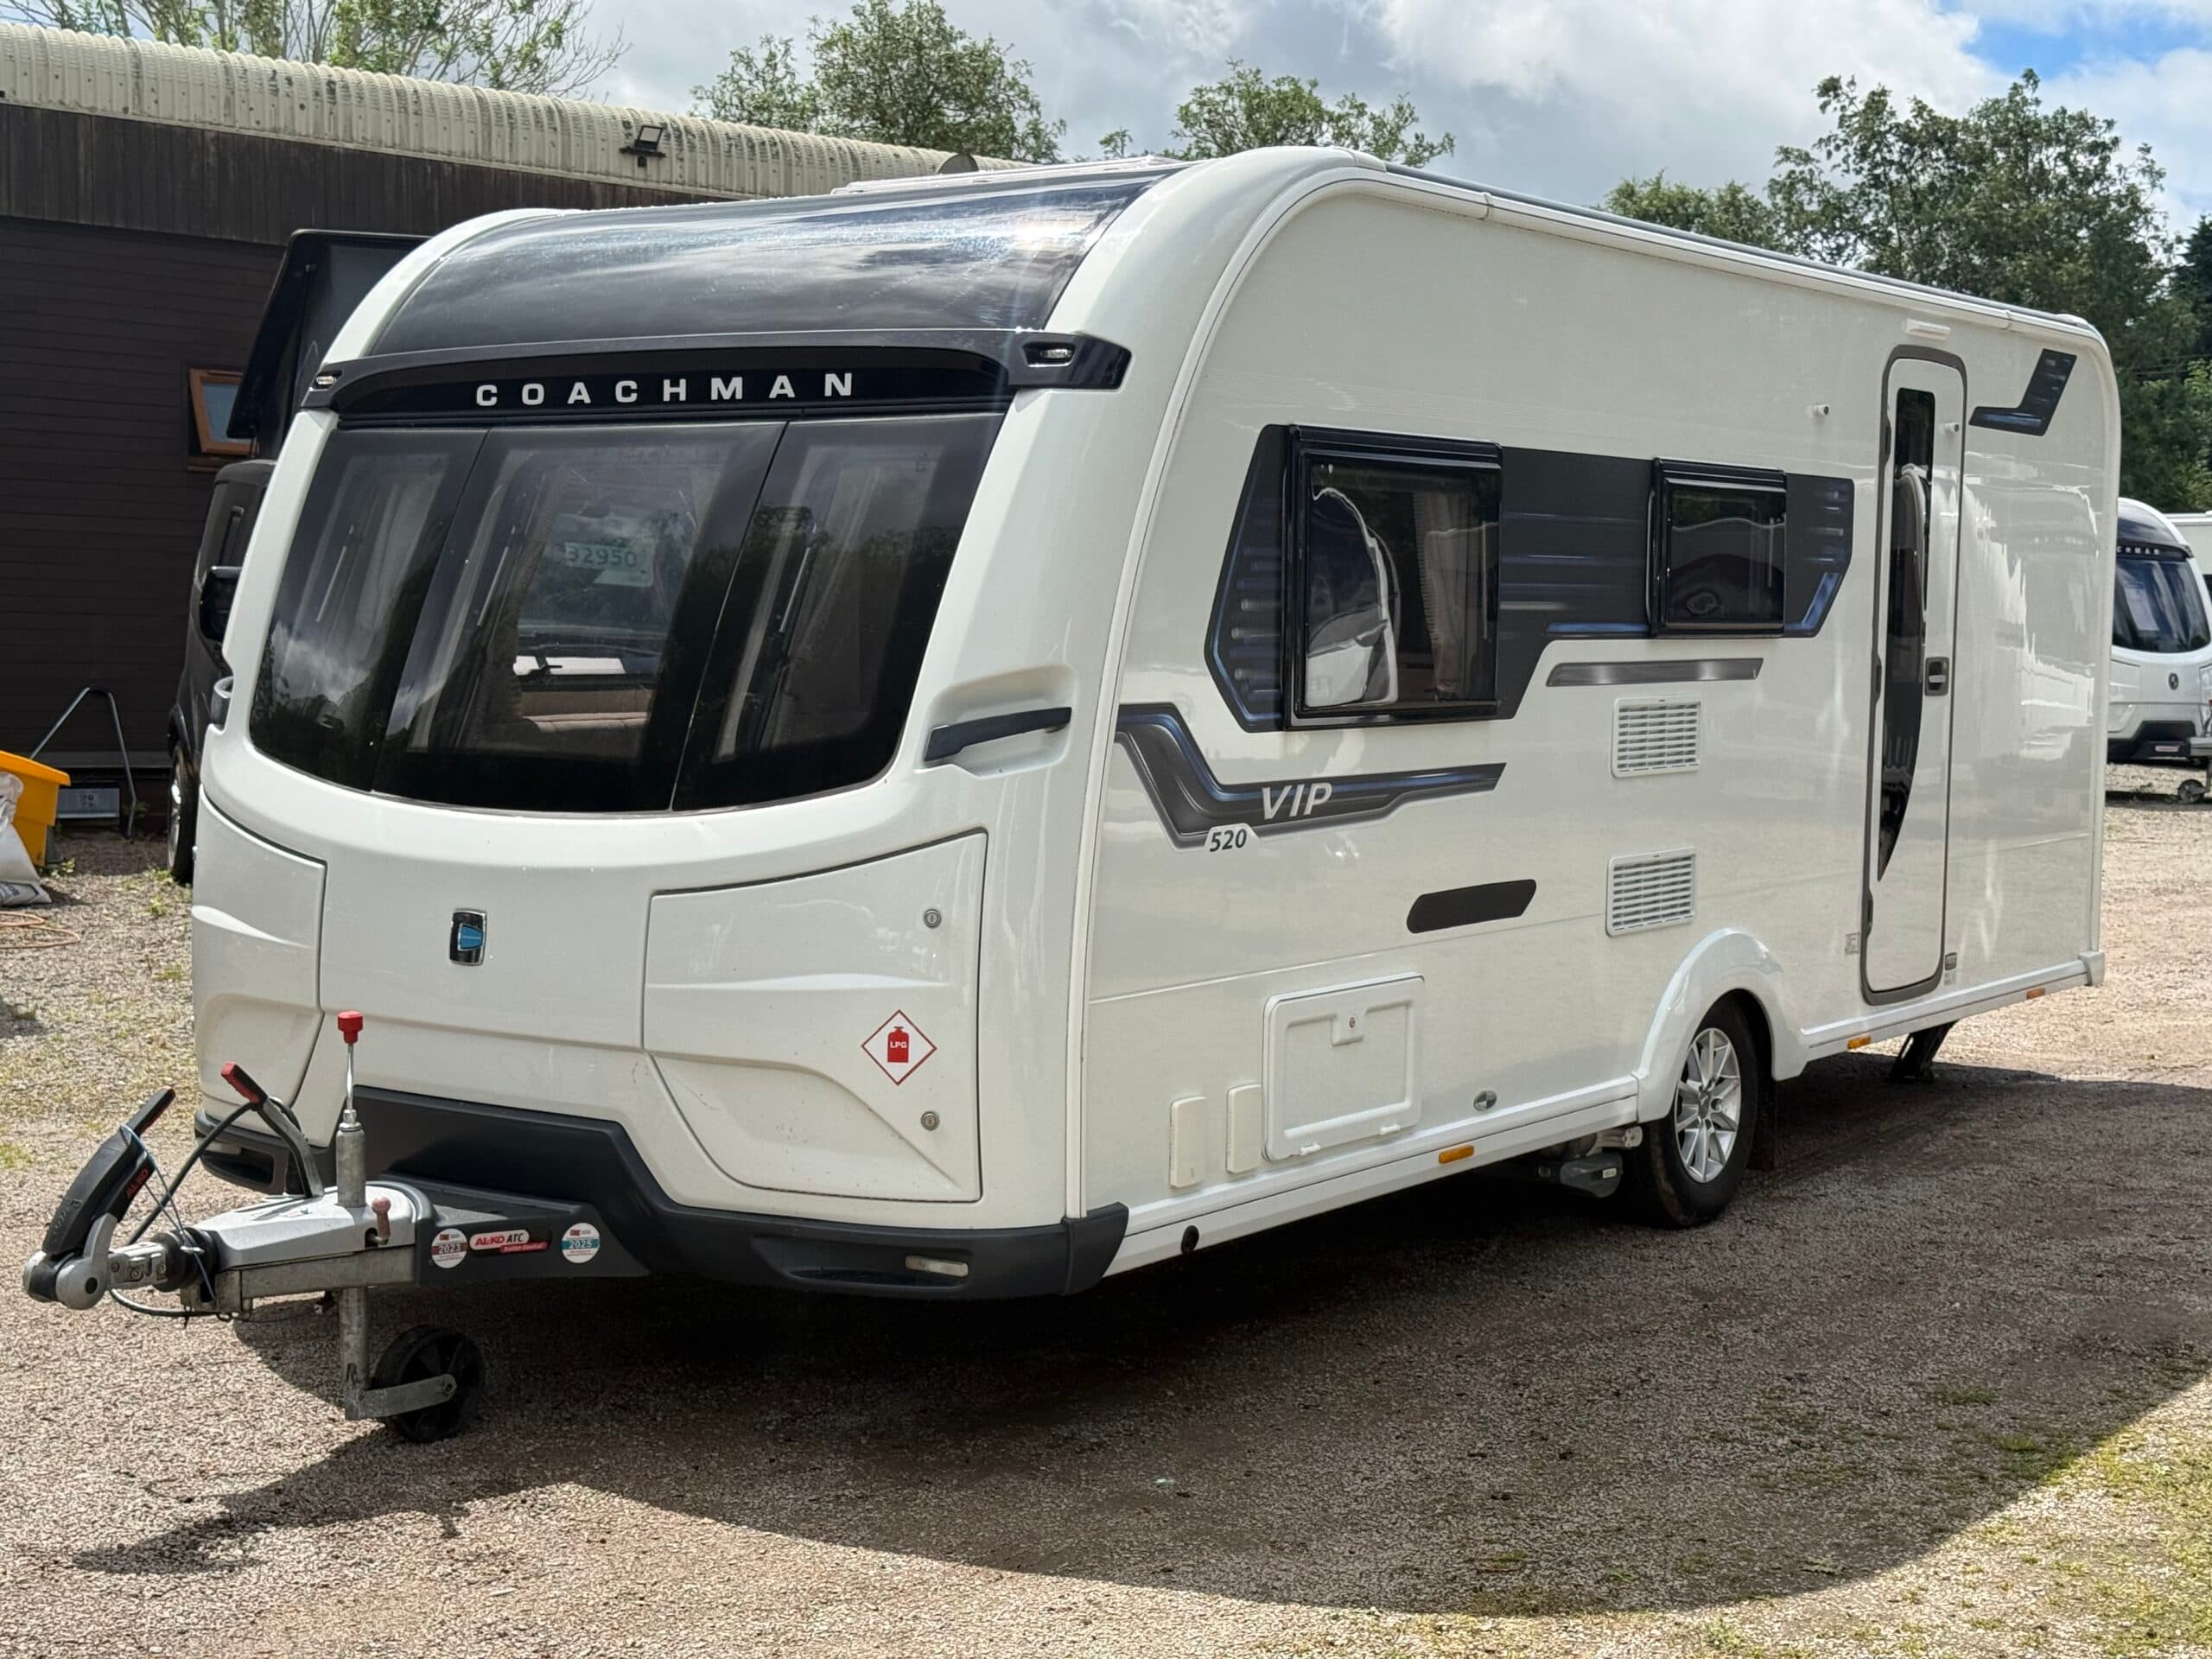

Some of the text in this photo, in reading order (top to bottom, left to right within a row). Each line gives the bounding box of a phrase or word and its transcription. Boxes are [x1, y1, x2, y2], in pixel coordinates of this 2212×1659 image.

[475, 372, 854, 407] COACHMAN
[565, 544, 638, 568] 32950
[1261, 782, 1332, 820] VIP
[1210, 829, 1248, 853] 520
[439, 1244, 461, 1255] 2023
[505, 1233, 524, 1243] ATC
[569, 1239, 592, 1249] 2025
